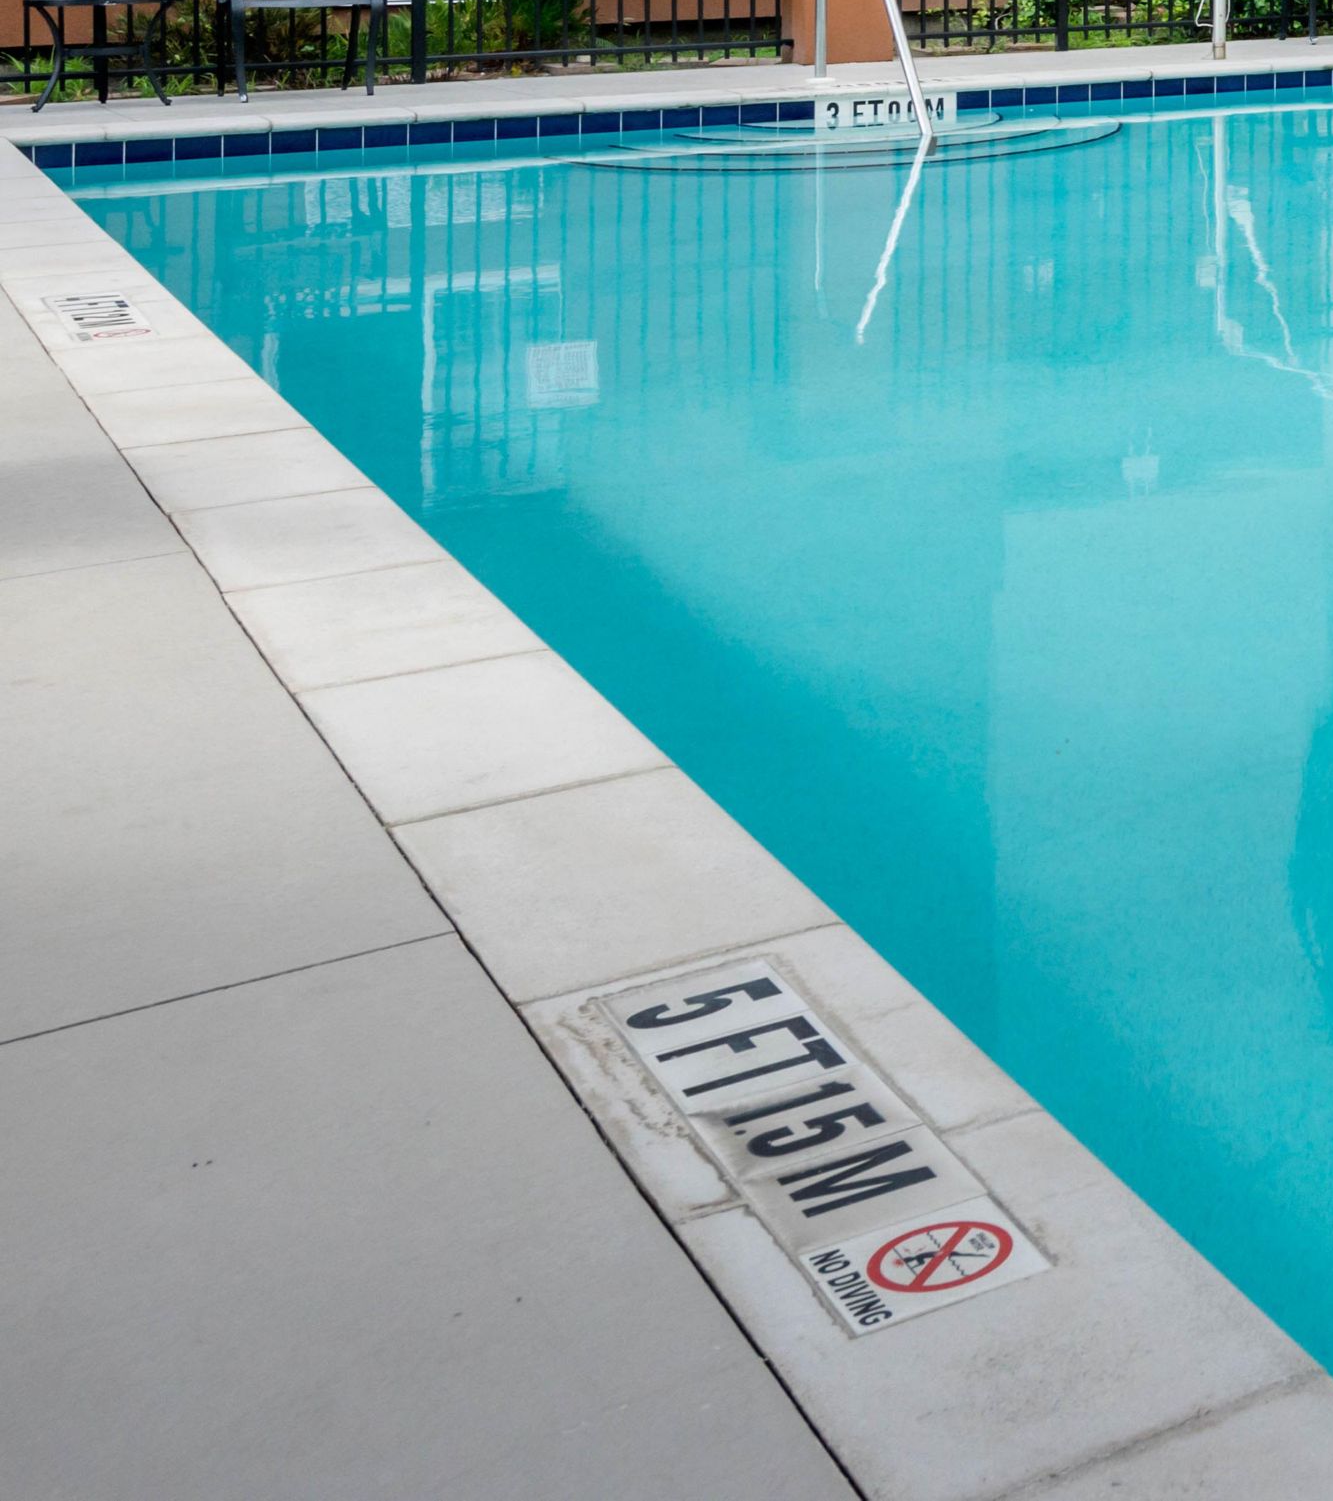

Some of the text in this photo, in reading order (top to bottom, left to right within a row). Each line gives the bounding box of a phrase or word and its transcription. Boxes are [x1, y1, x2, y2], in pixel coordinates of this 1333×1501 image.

[625, 977, 783, 1030] 5
[655, 1015, 847, 1098] FT
[777, 1140, 937, 1219] M
[809, 1248, 893, 1328] NO DIVING
